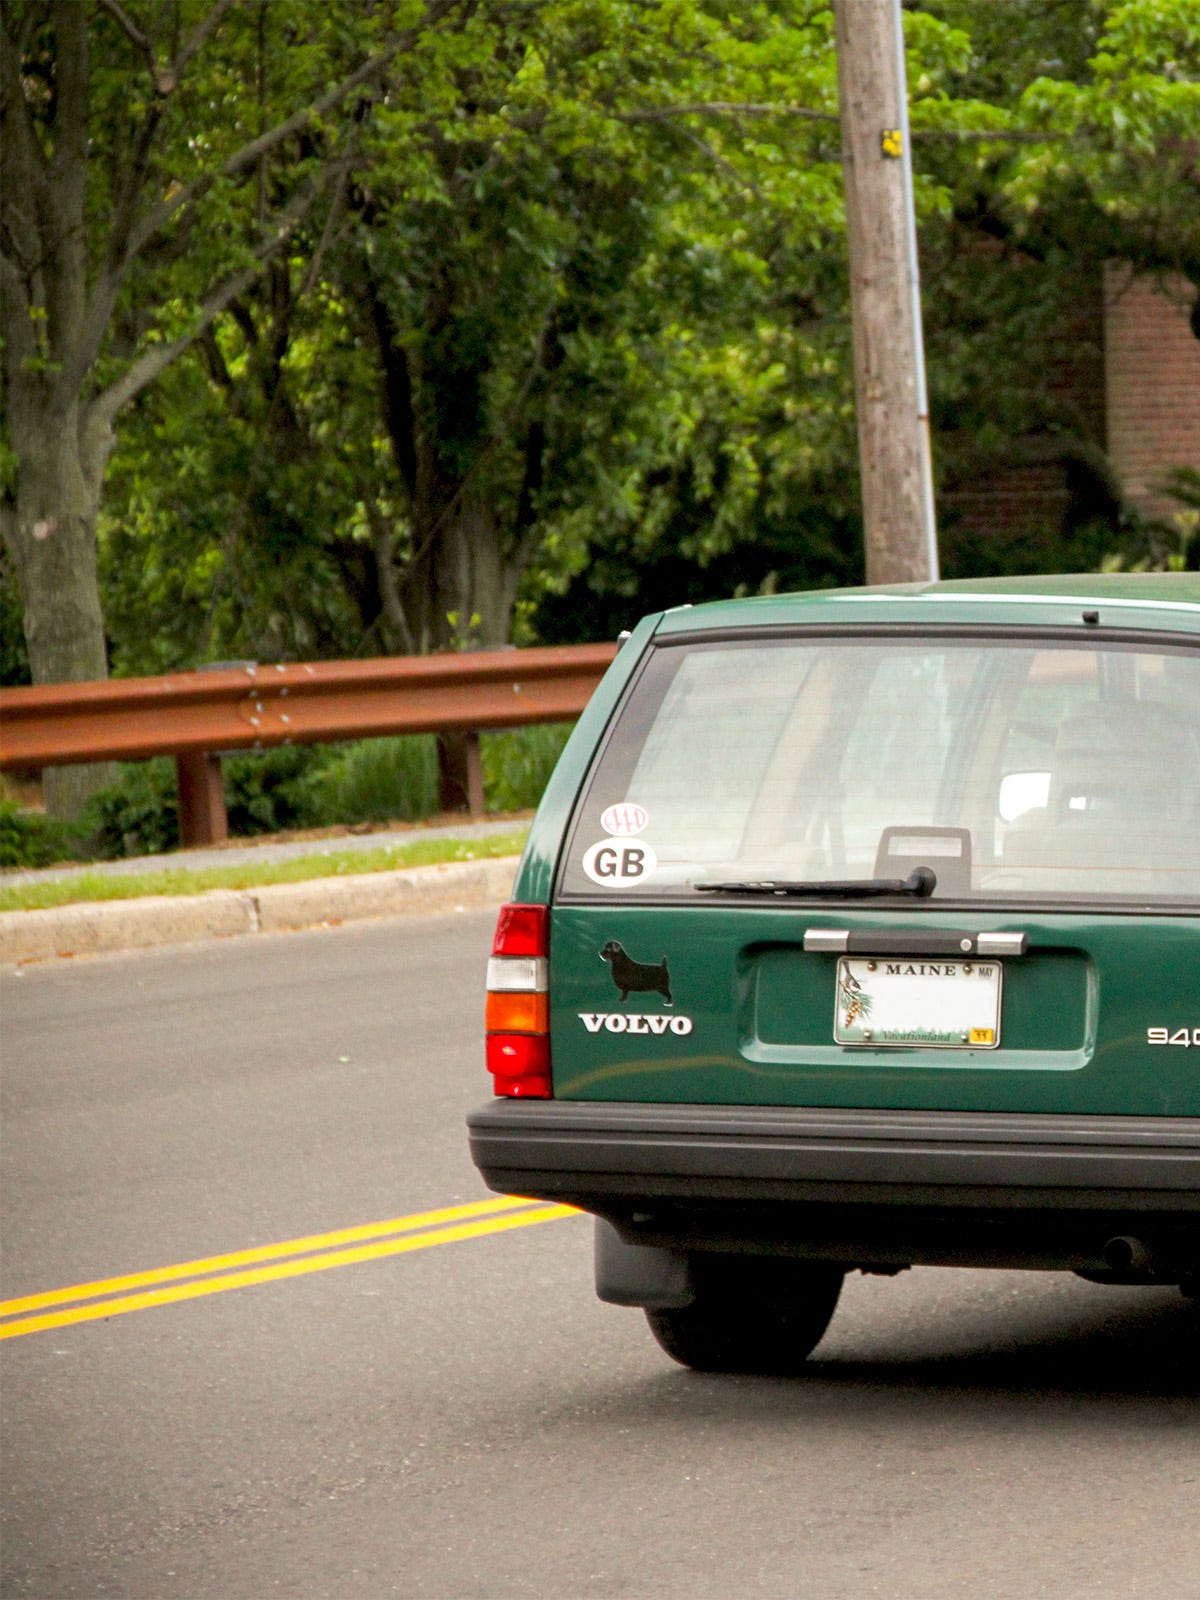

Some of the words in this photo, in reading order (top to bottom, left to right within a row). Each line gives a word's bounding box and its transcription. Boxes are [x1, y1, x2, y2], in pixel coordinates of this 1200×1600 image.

[593, 847, 645, 878] GB
[886, 964, 956, 976] MAINE
[979, 967, 993, 977] MAY
[578, 1013, 694, 1036] VOLVO
[883, 1031, 951, 1042] Vacationland
